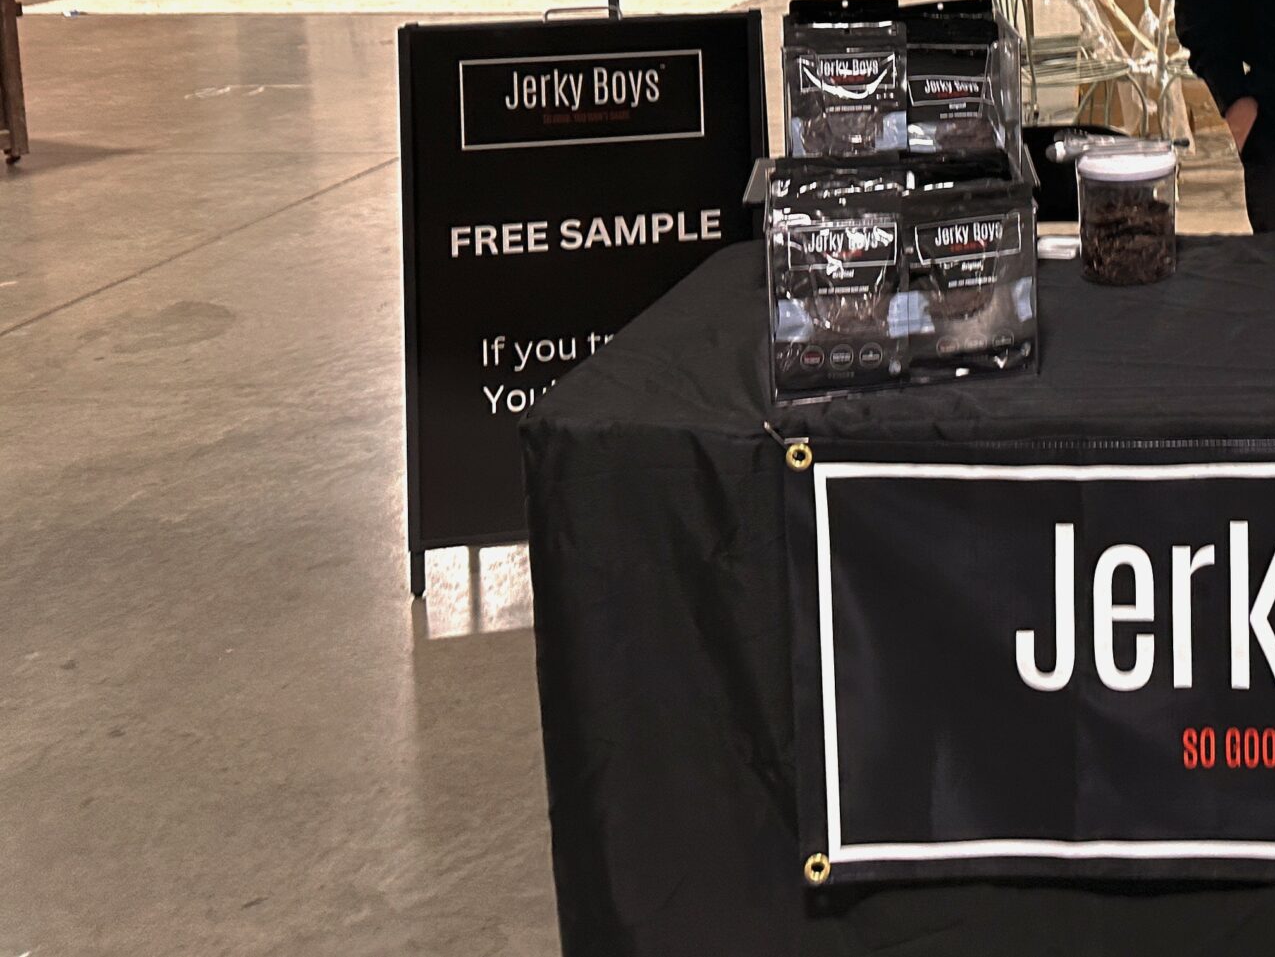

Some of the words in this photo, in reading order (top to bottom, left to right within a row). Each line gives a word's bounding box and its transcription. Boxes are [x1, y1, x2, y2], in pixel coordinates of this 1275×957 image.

[505, 68, 583, 111] Jerky
[593, 66, 660, 108] Boys
[451, 221, 549, 258] FREE
[560, 209, 721, 250] SAMPLE
[934, 224, 968, 246] Jerky
[482, 335, 506, 367] If
[514, 337, 577, 373] you
[1182, 727, 1217, 770] SO
